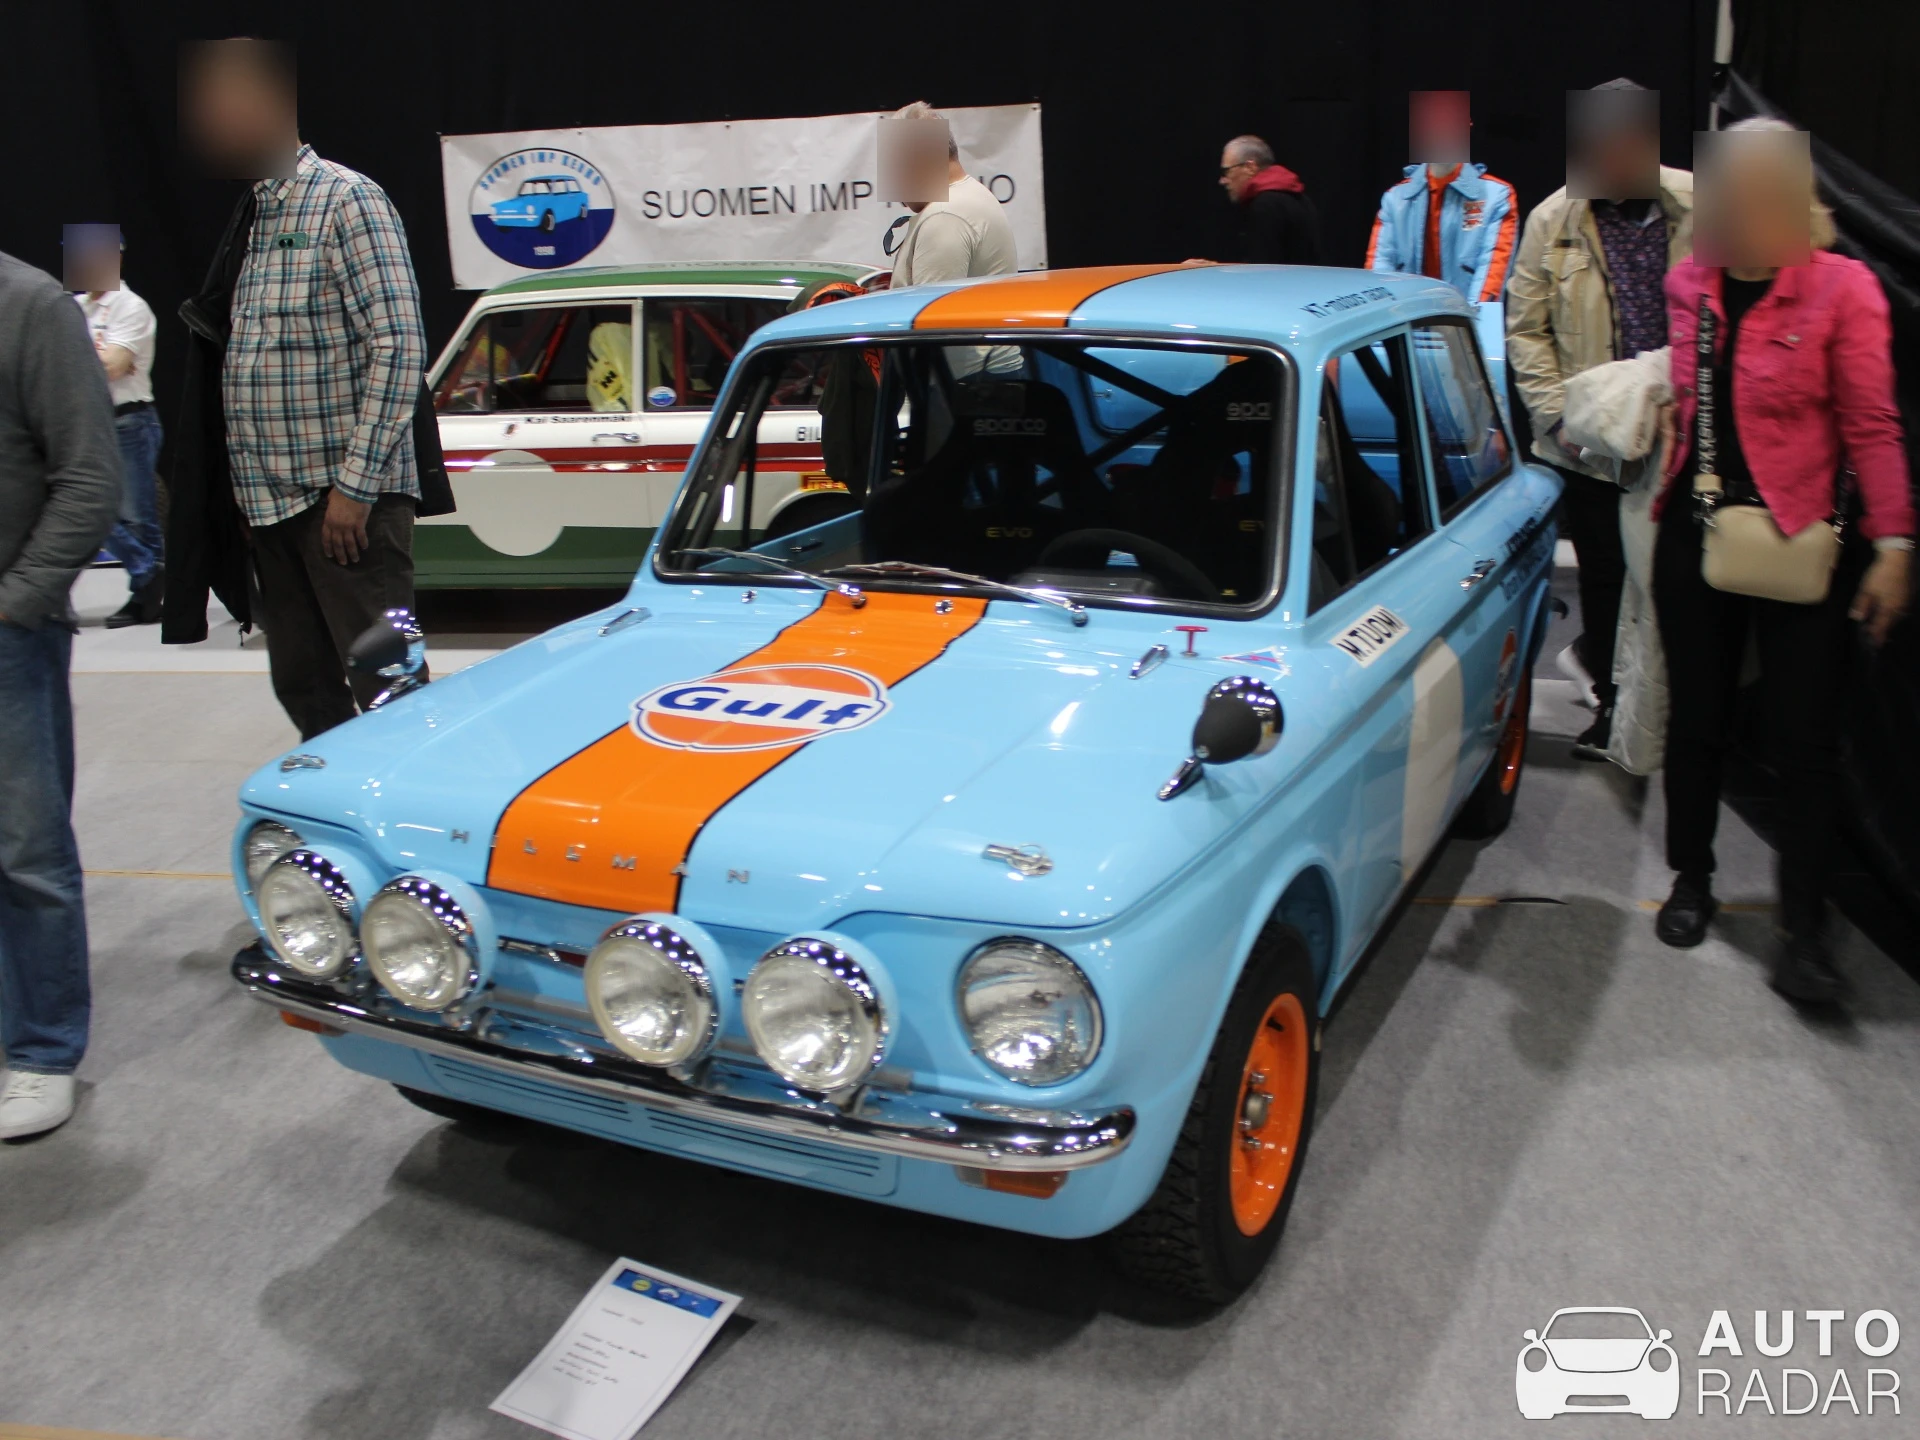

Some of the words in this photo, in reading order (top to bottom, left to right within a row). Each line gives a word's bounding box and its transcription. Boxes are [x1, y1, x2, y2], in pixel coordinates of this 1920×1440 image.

[642, 185, 796, 219] SUOMEN
[811, 180, 873, 213] IMP
[524, 416, 546, 424] Kai
[1227, 402, 1271, 421] spa
[973, 418, 1047, 435] sparco
[985, 527, 1033, 538] EVO
[657, 686, 873, 725] Gulf
